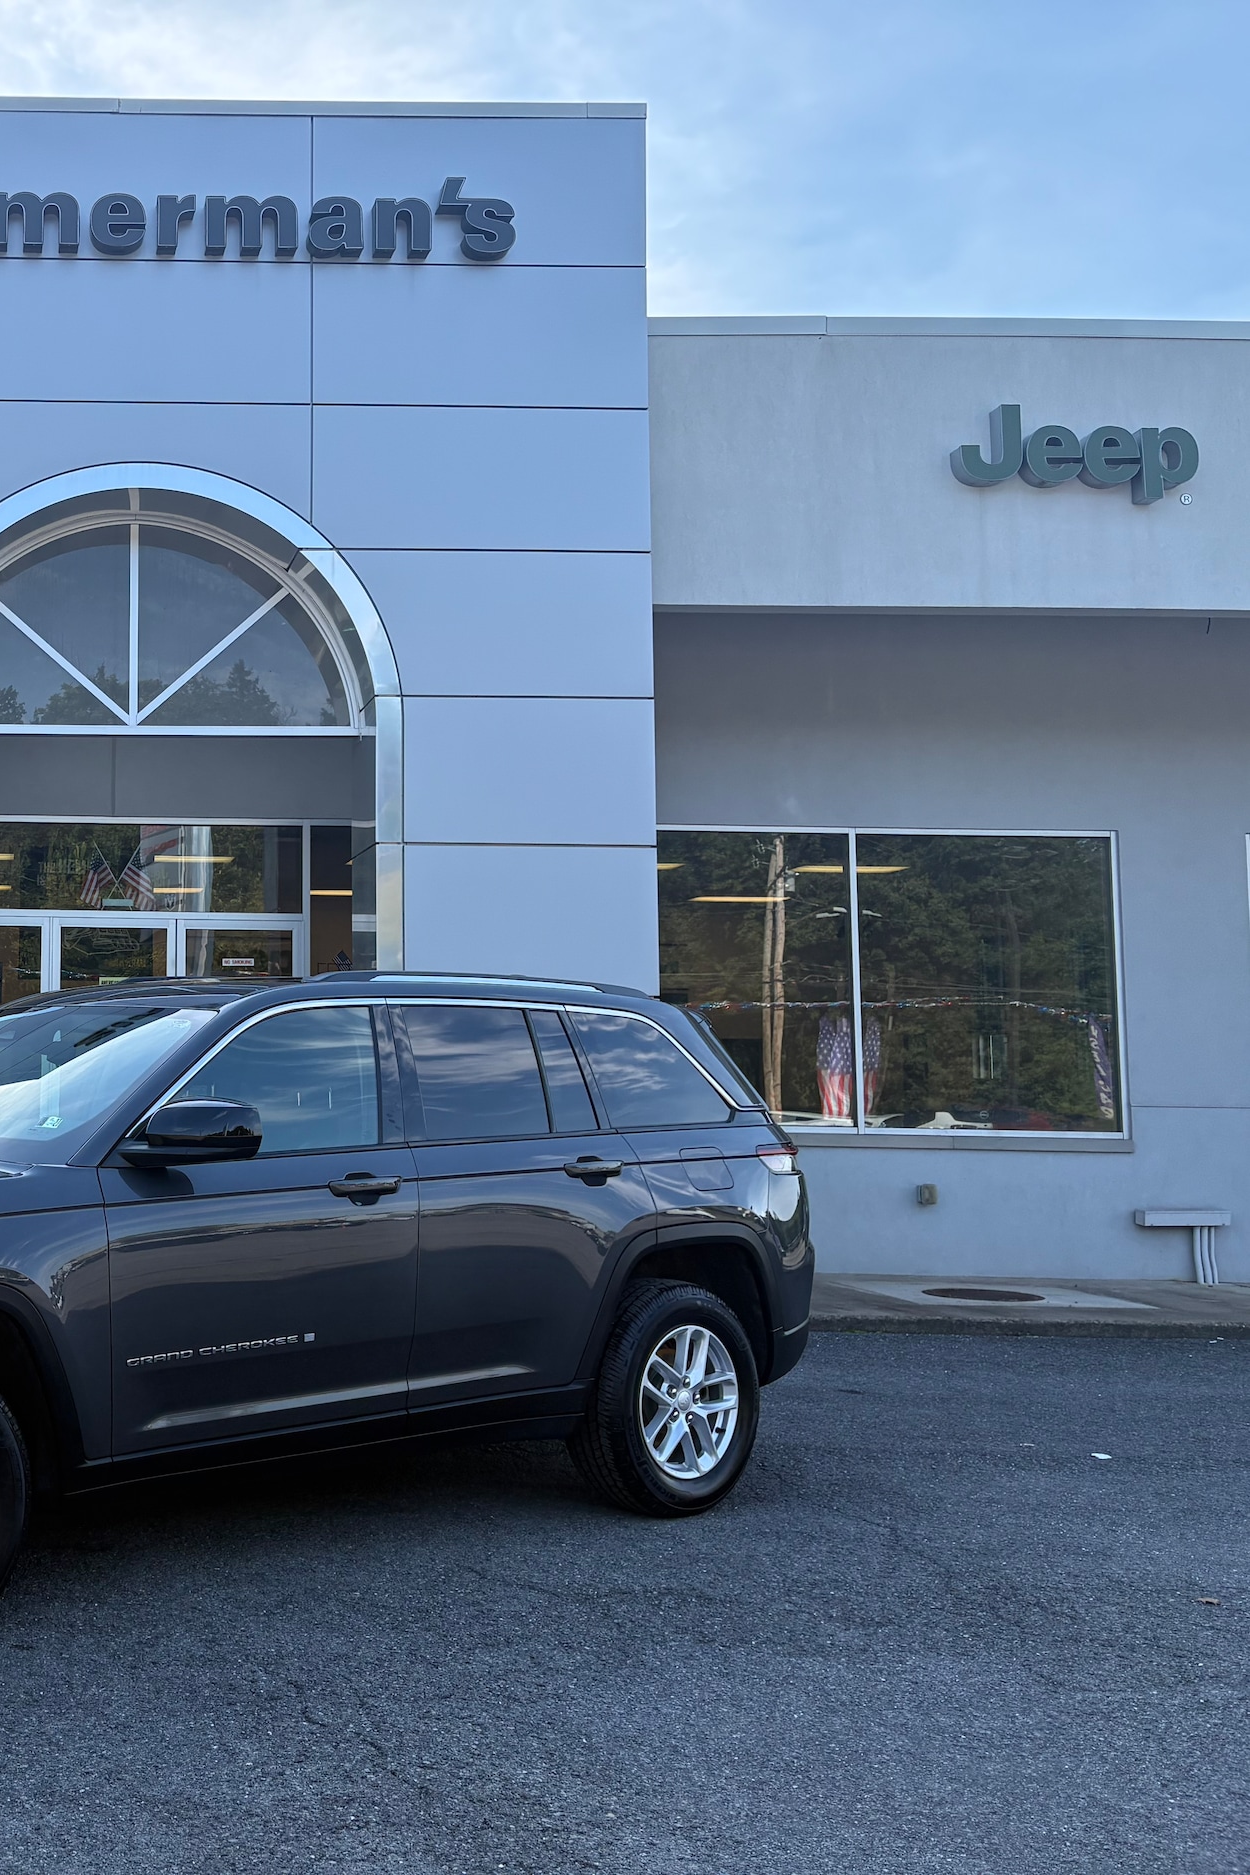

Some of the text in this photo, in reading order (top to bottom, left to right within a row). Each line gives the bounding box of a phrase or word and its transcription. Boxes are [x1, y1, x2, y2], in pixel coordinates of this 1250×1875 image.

[949, 403, 1200, 505] Jeep
[126, 1334, 299, 1367] GRAND CHEROKEE
